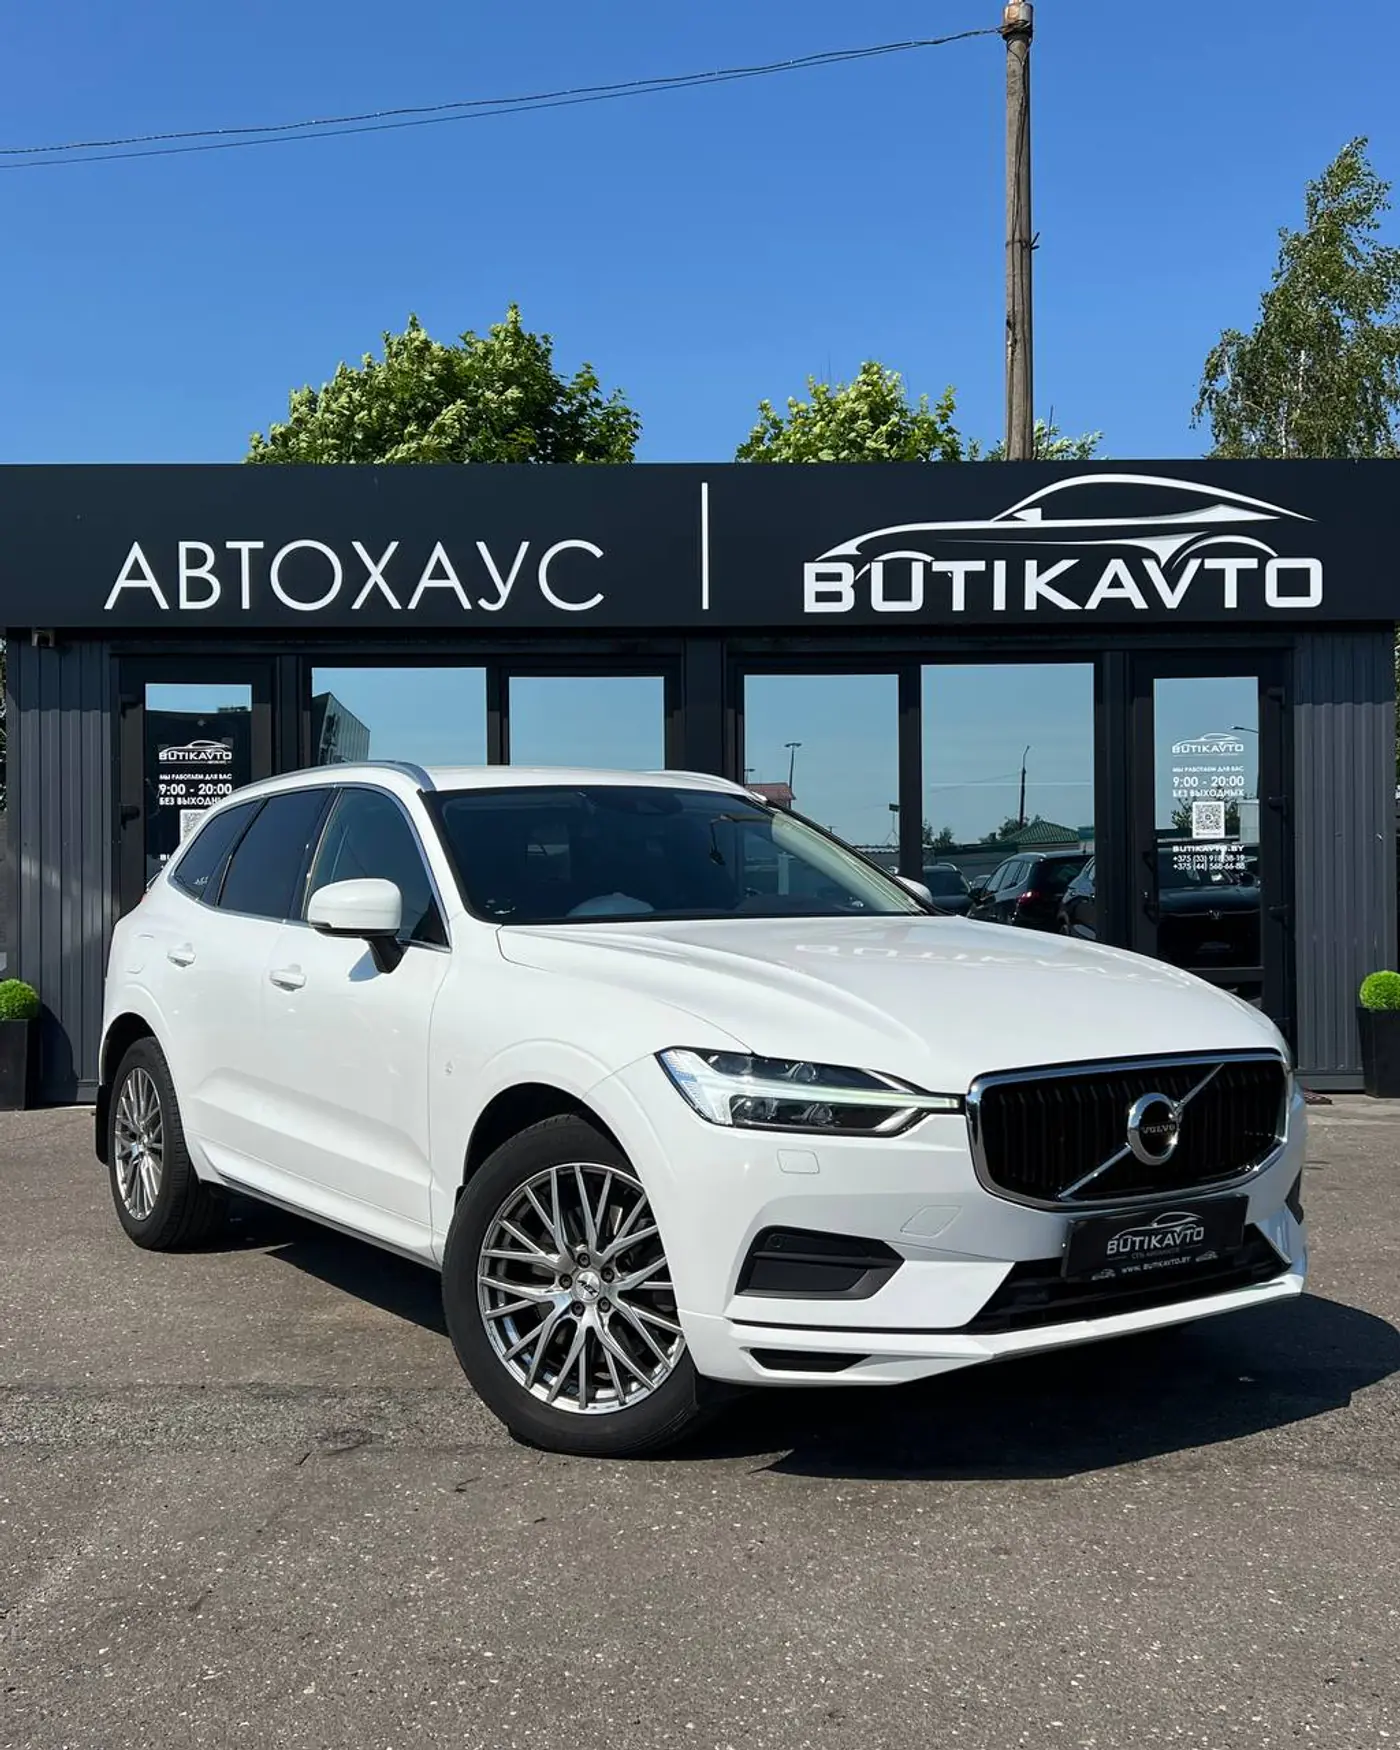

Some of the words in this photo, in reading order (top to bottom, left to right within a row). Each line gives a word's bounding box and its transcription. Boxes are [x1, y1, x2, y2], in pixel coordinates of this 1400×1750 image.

[103, 539, 605, 612] АВТОХАУС
[803, 556, 1324, 614] BUTIKAVTO
[1172, 744, 1243, 753] BUTIKAVTO
[159, 752, 232, 760] BUTIKAVTO
[1172, 776, 1199, 788] 9:00
[1210, 775, 1245, 787] 20:00
[158, 783, 186, 795] 9:00
[198, 783, 233, 795] 20:00
[1189, 789, 1245, 798] ВЫХОДНЫХ
[159, 797, 175, 806] БЕЗ
[176, 796, 219, 806] ВЫХОДН
[1172, 845, 1245, 853] BUTIKAVTO.BY
[1173, 854, 1192, 863] +375
[1192, 854, 1208, 863] (33)
[1173, 862, 1192, 871] +375
[1192, 862, 1208, 872] (44)
[1141, 1123, 1176, 1135] VOLVO
[1107, 1227, 1204, 1255] BUTIKAVTO
